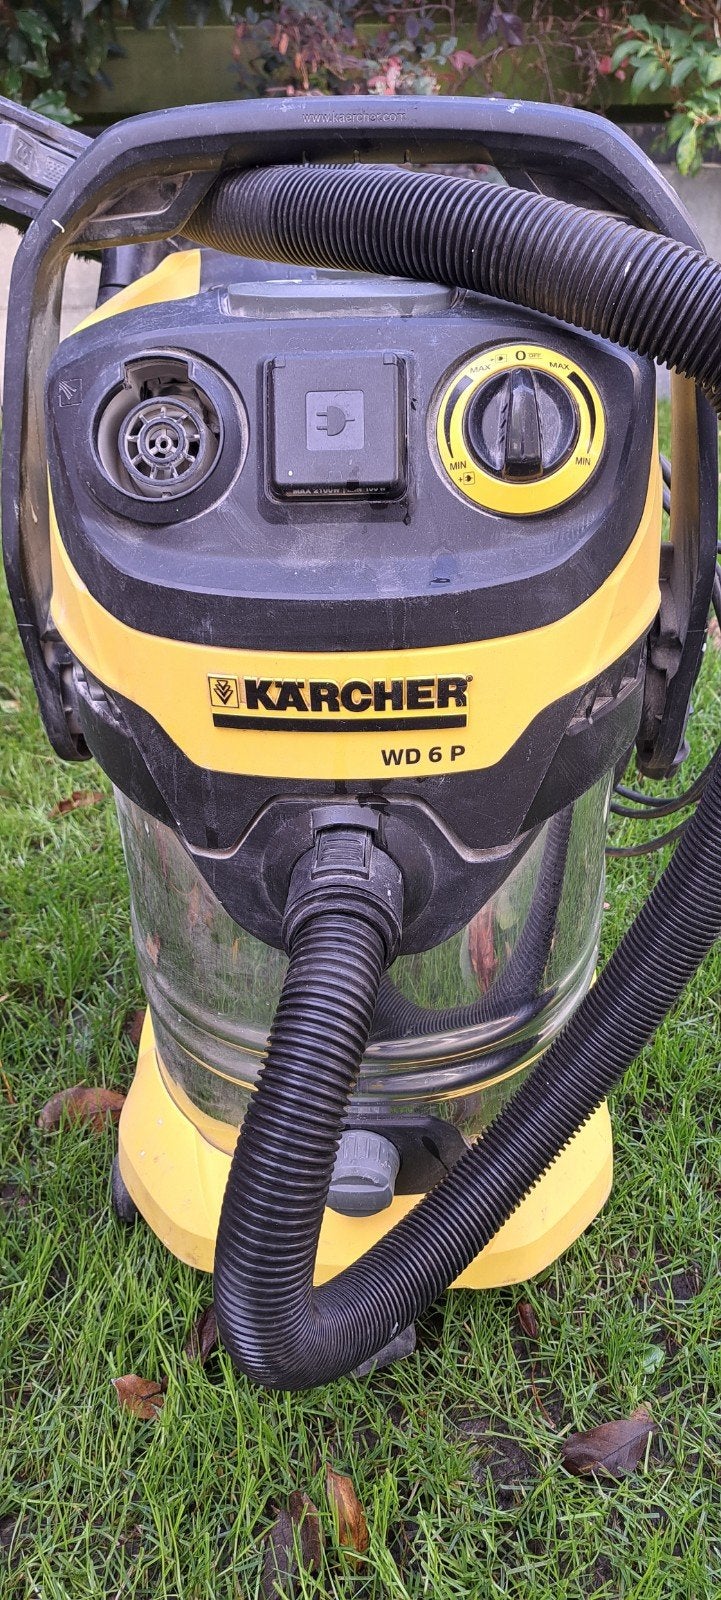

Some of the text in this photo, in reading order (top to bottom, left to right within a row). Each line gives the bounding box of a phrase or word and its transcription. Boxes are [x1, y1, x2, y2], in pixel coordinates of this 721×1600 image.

[470, 364, 492, 374] MAX
[549, 361, 570, 371] MAX
[449, 460, 467, 471] MIN
[574, 456, 591, 466] MIN
[381, 745, 466, 766] WD 6 P
